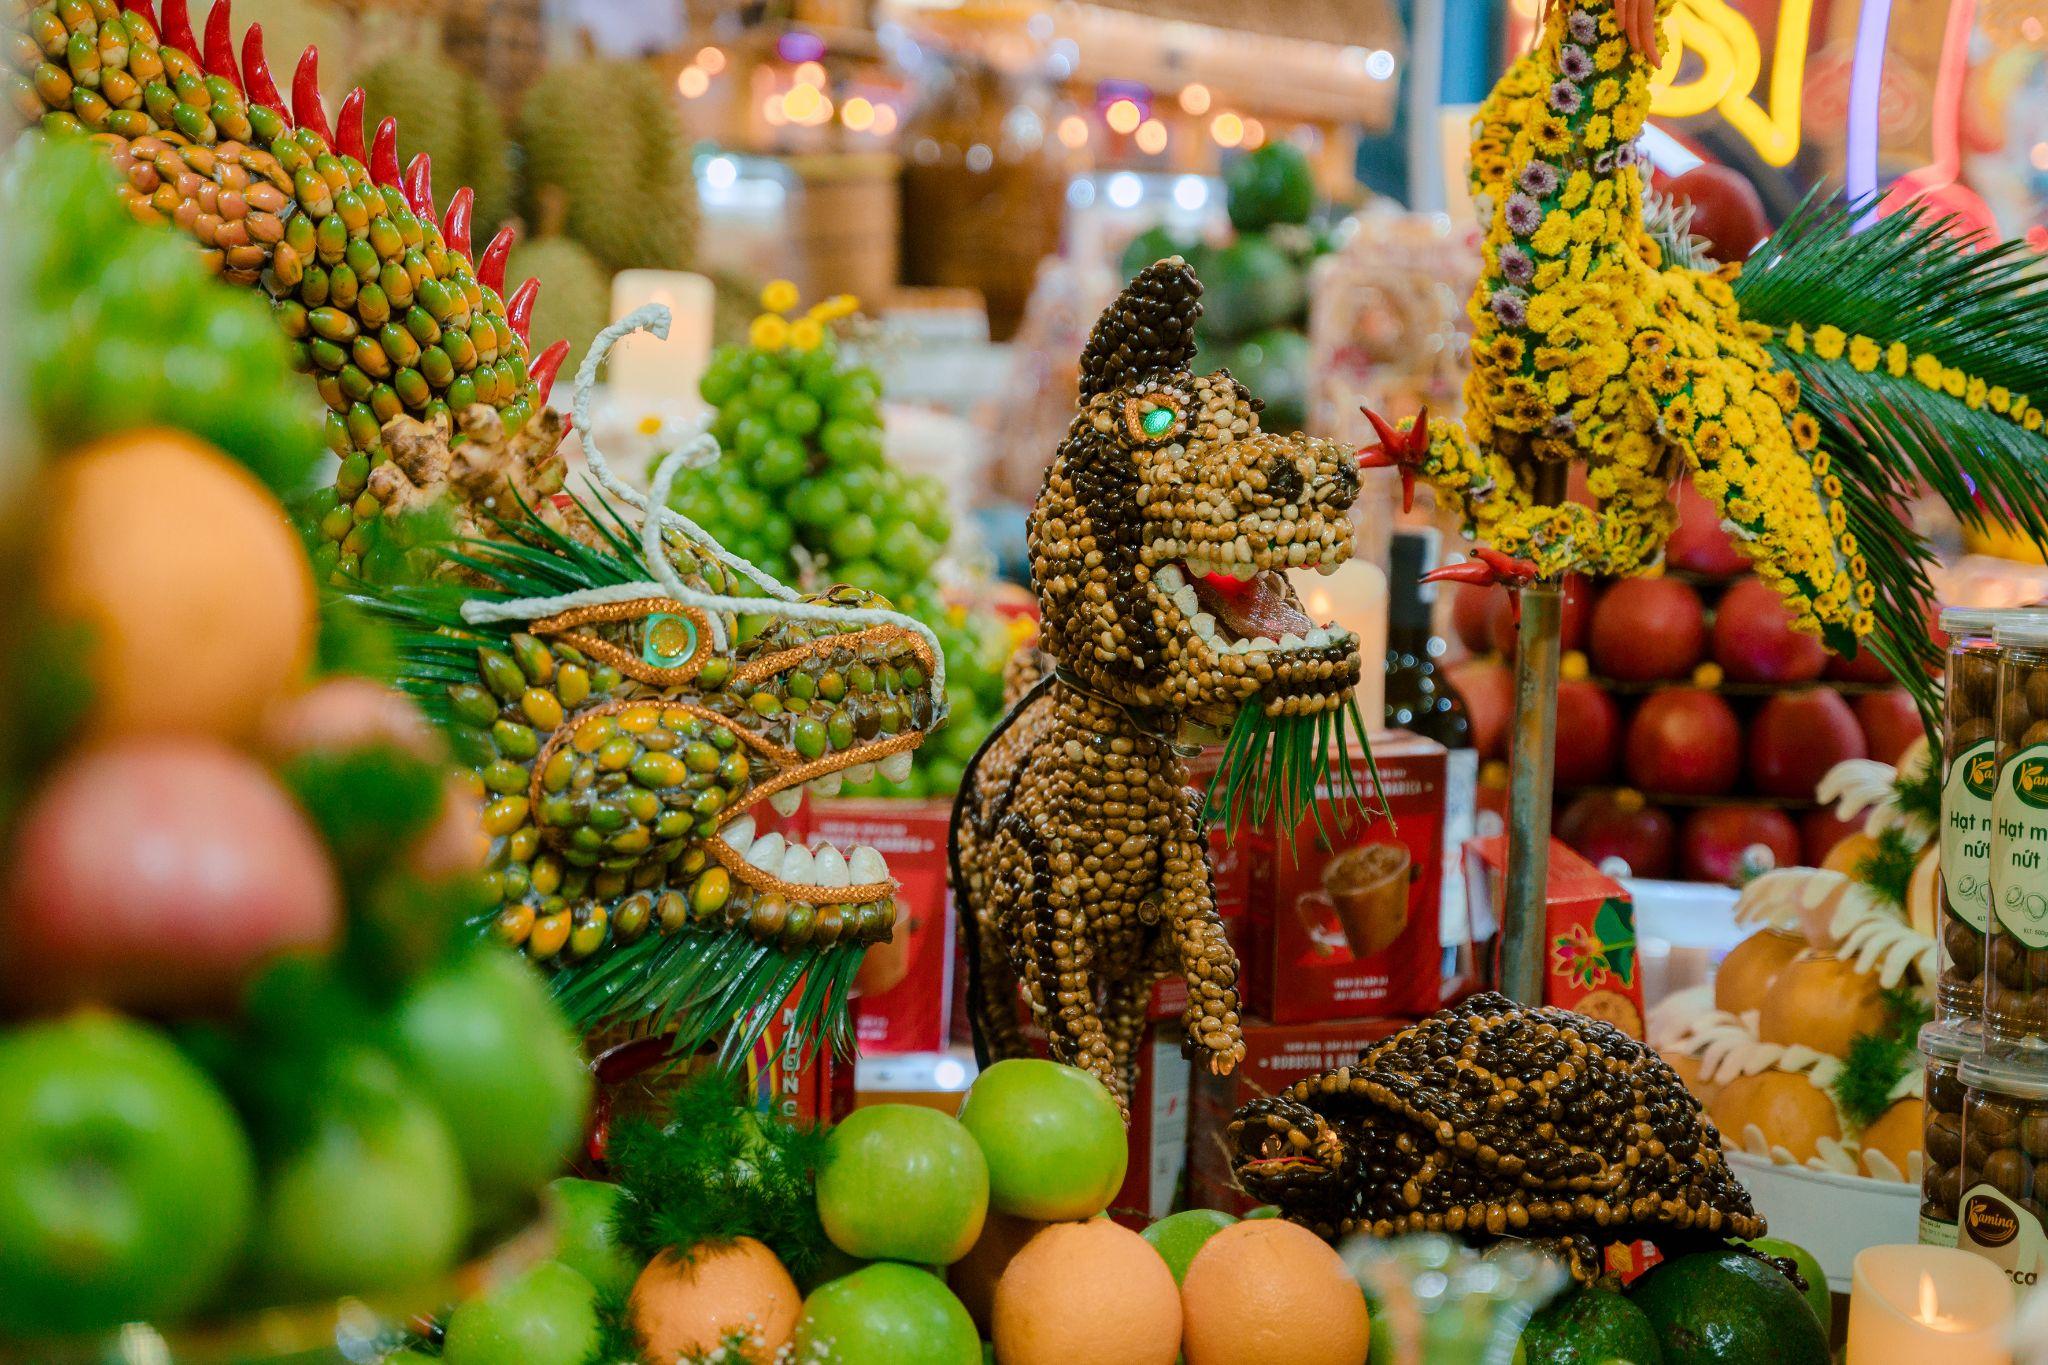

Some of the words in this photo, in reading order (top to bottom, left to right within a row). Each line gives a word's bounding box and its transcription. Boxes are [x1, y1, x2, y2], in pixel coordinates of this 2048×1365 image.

[1950, 811, 1976, 834] Hạt
[1999, 817, 2024, 842] Hạt
[2012, 849, 2041, 869] nứt
[1967, 1199, 2015, 1228] Kamina
